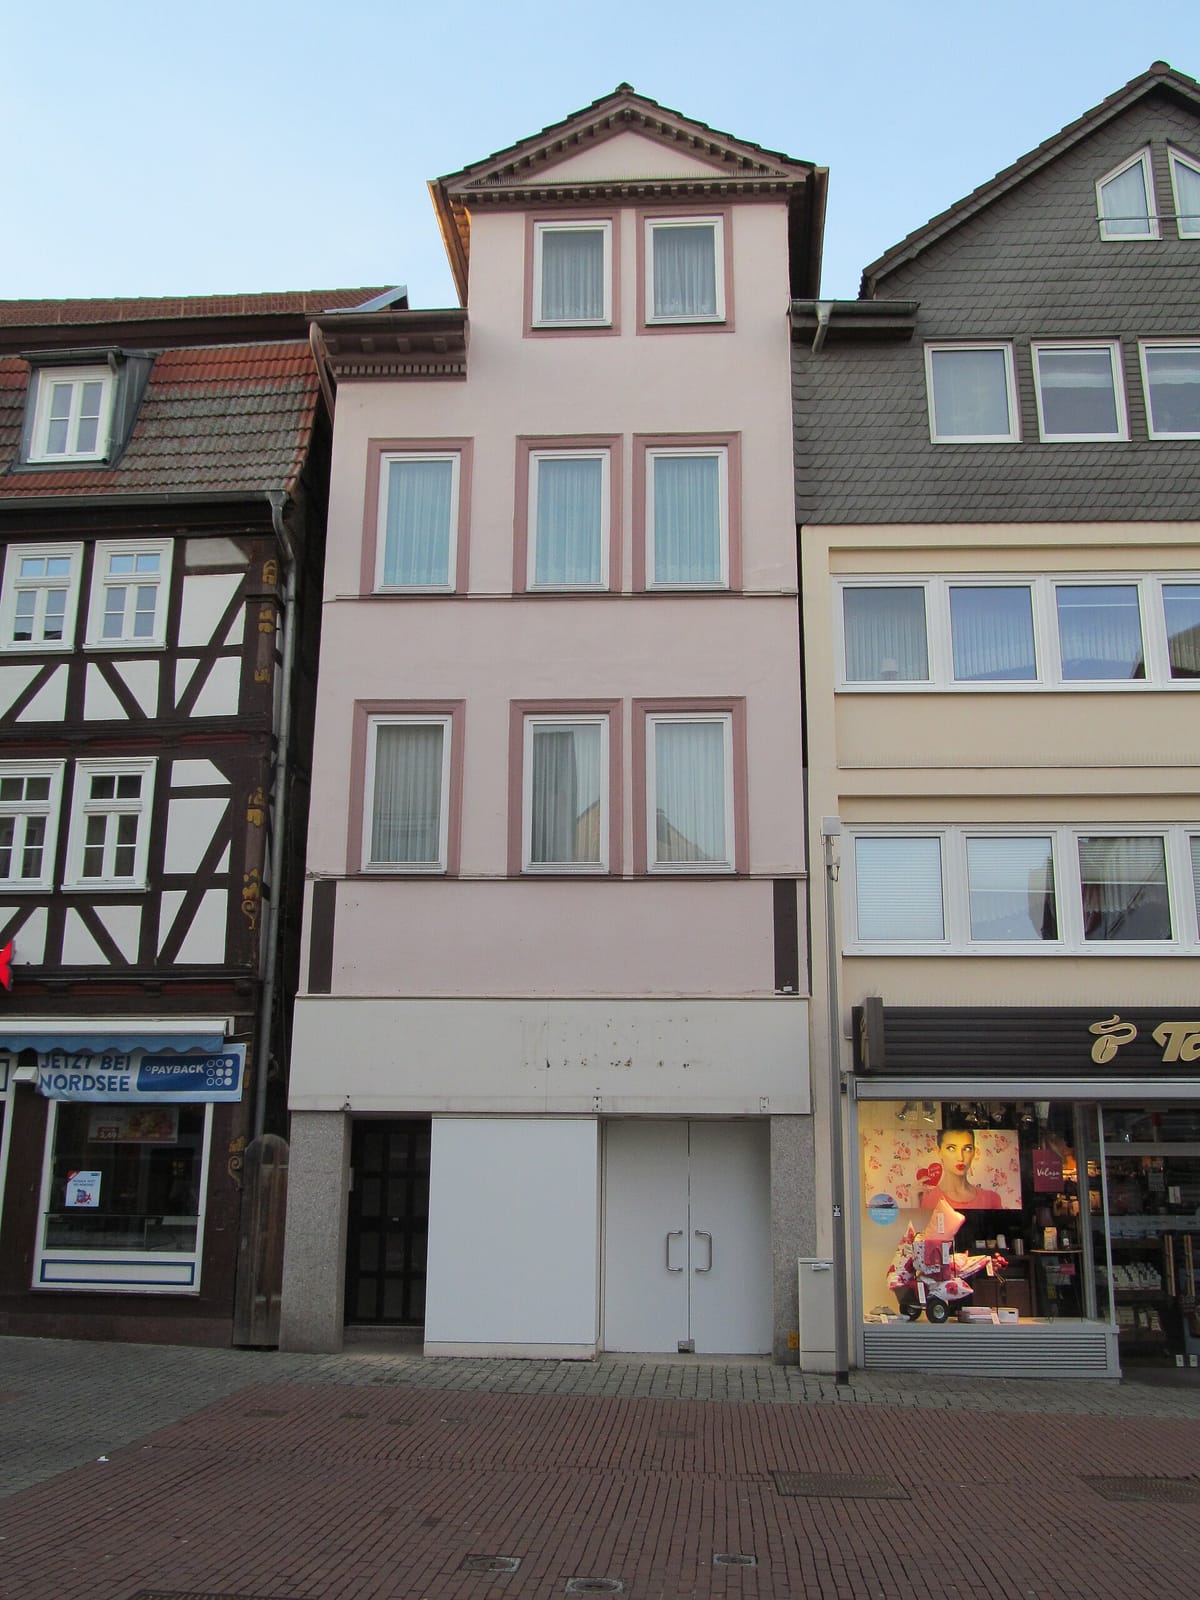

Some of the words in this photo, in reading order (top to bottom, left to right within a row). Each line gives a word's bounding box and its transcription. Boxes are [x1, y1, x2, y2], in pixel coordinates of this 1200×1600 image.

[40, 1054, 92, 1069] JETZT
[100, 1055, 131, 1071] BEI
[151, 1064, 205, 1075] PAYBACK
[39, 1074, 131, 1092] NORDSEE
